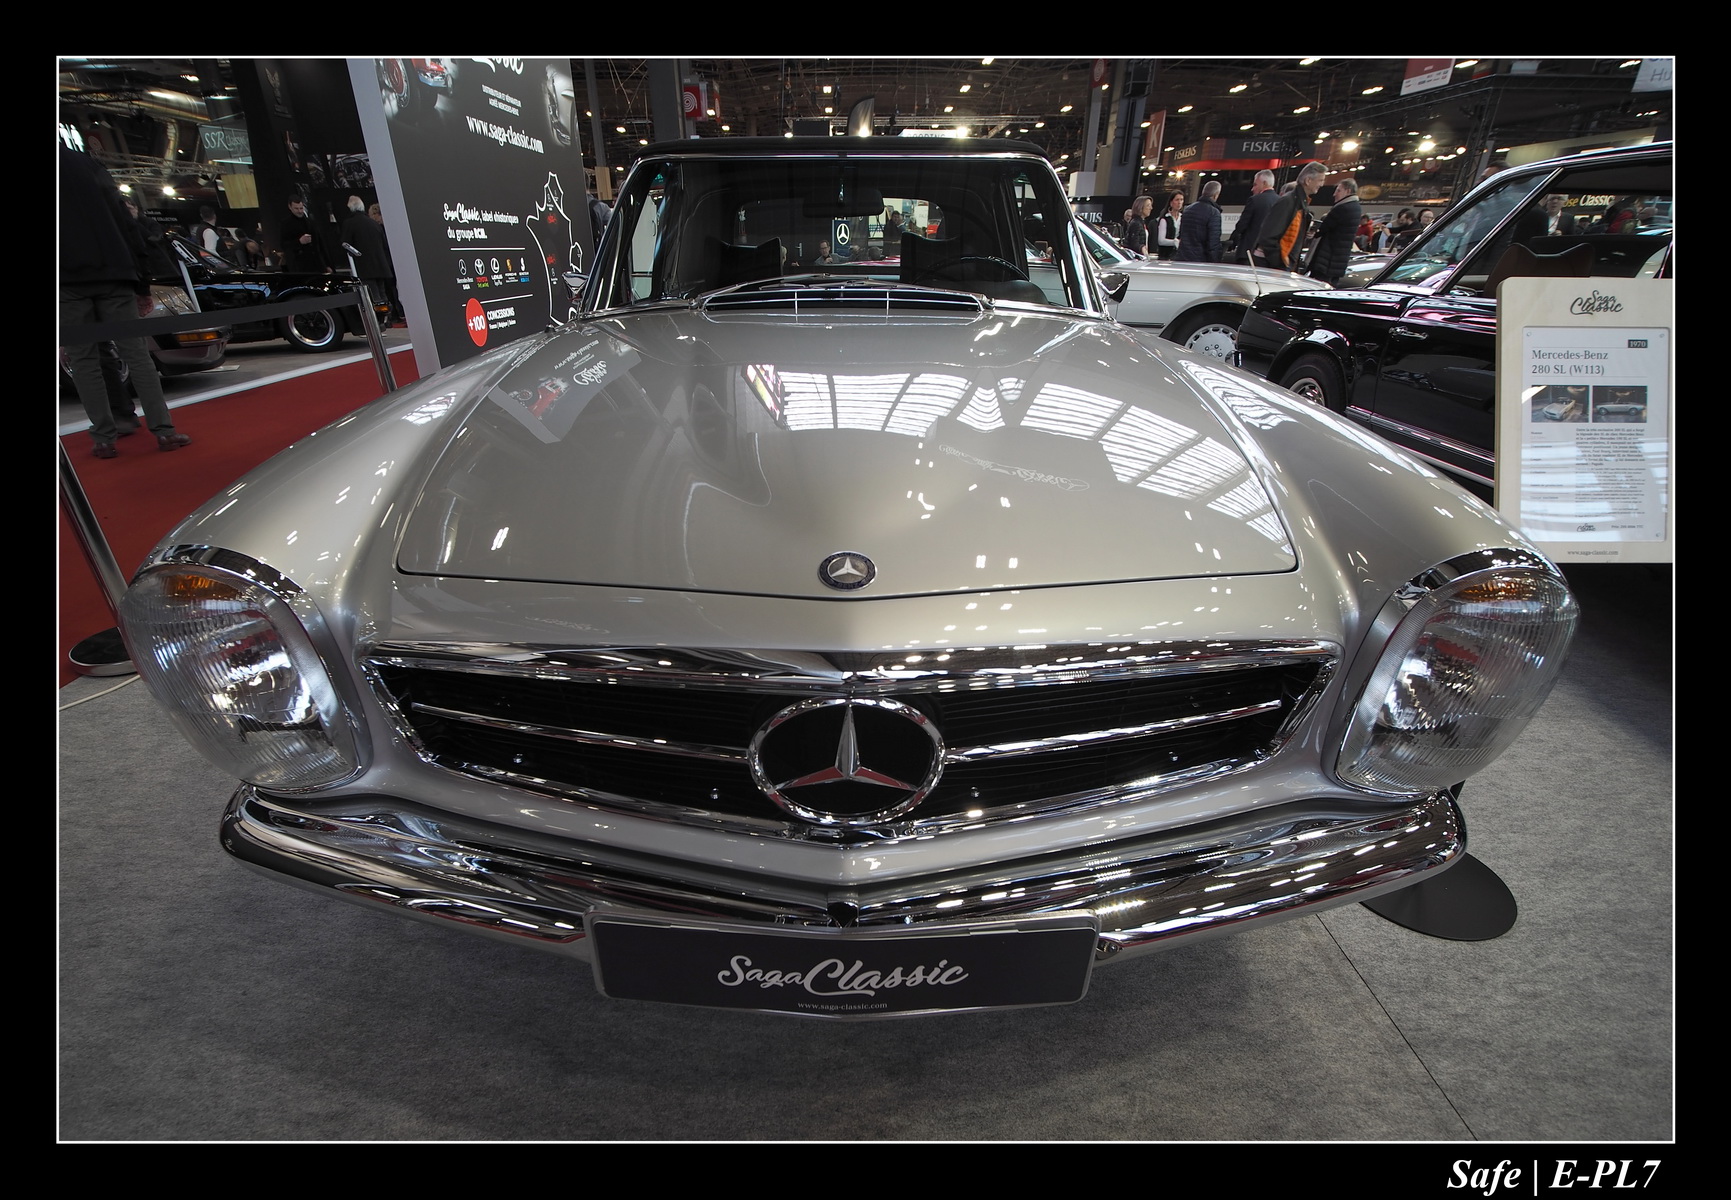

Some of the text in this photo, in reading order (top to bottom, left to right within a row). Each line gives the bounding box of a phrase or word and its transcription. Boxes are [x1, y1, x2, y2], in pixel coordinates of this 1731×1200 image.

[465, 115, 545, 154] www.saga-classic.com
[1174, 145, 1197, 160] FISKENS
[1242, 141, 1294, 153] FISKE
[1591, 289, 1617, 303] Saga
[1570, 296, 1624, 315] Classic
[468, 315, 486, 331] +100
[1531, 350, 1610, 361] Mercedes-Benz
[1531, 364, 1605, 376] 280 SL (W113)
[797, 1002, 888, 1011] www.saga-classic.com
